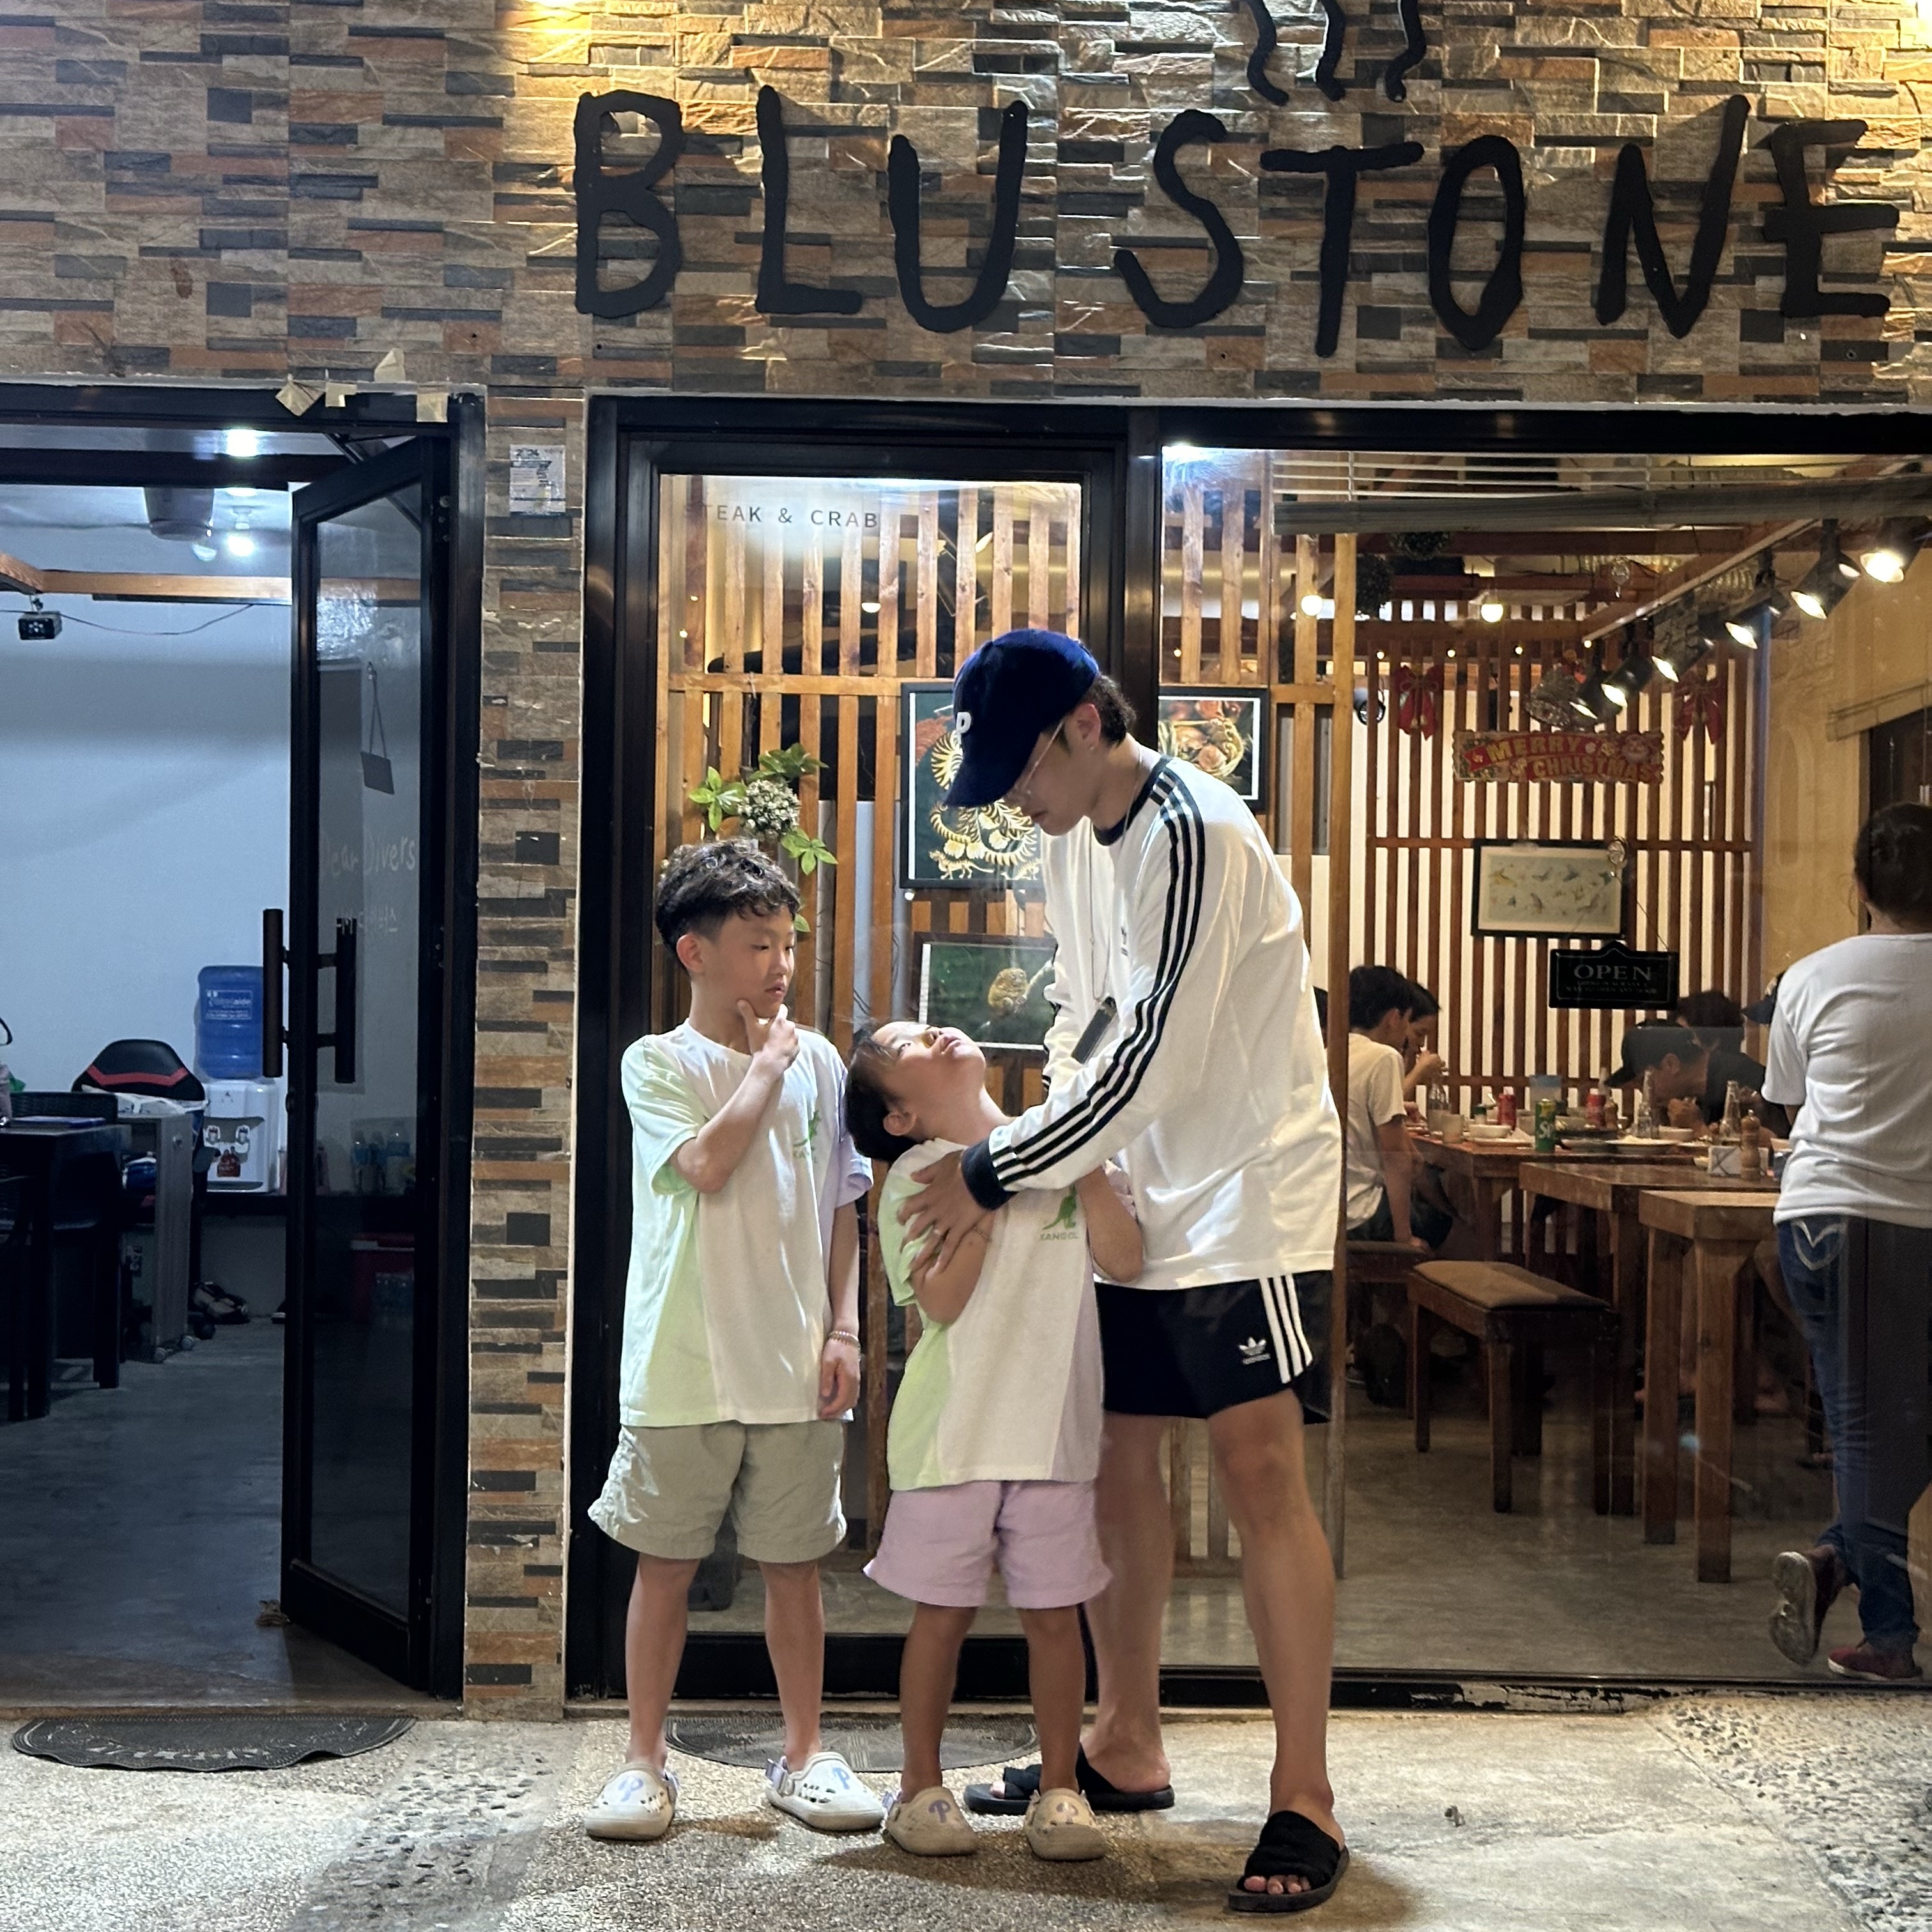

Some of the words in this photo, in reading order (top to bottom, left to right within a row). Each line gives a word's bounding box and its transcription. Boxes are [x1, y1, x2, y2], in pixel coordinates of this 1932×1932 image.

[778, 507, 792, 524] &
[811, 509, 878, 528] CRAB
[1486, 735, 1581, 762] MERRY
[1533, 755, 1653, 779] CHRISTMAS
[1574, 964, 1652, 981] OPEN
